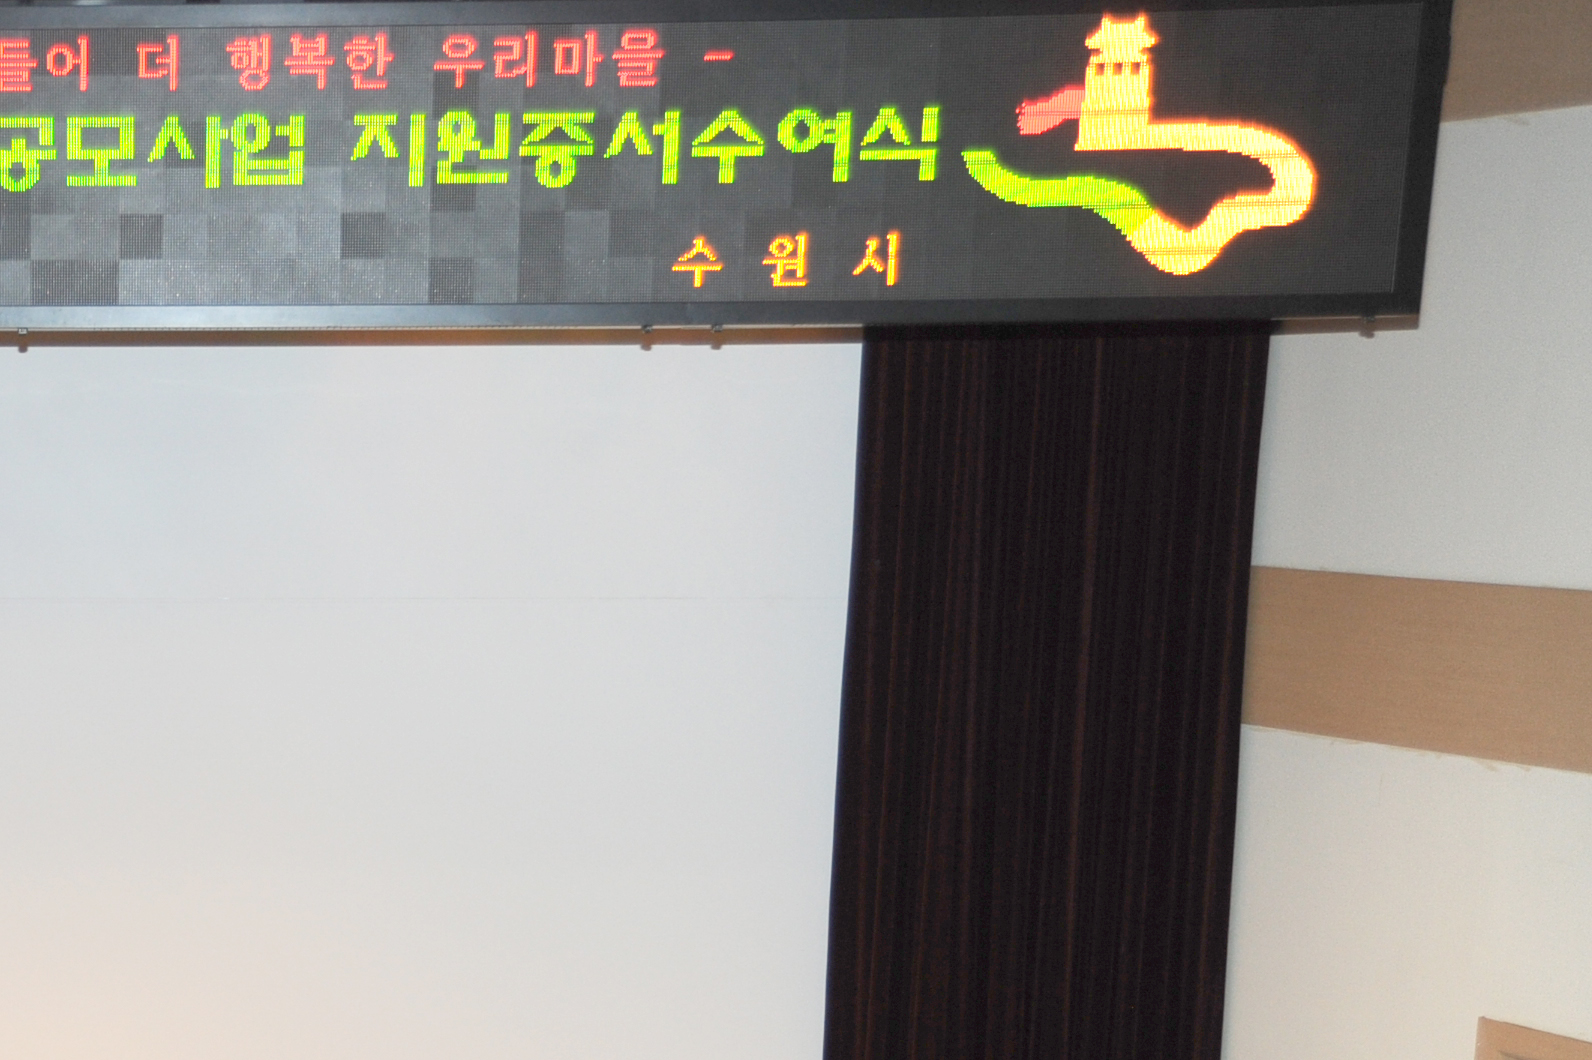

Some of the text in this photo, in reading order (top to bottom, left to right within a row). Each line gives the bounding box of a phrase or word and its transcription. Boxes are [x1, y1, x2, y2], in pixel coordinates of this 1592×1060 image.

[138, 36, 179, 91] 더
[228, 34, 394, 90] 행복한
[434, 30, 664, 88] 우리마을
[352, 106, 940, 188] 지원증서수여식
